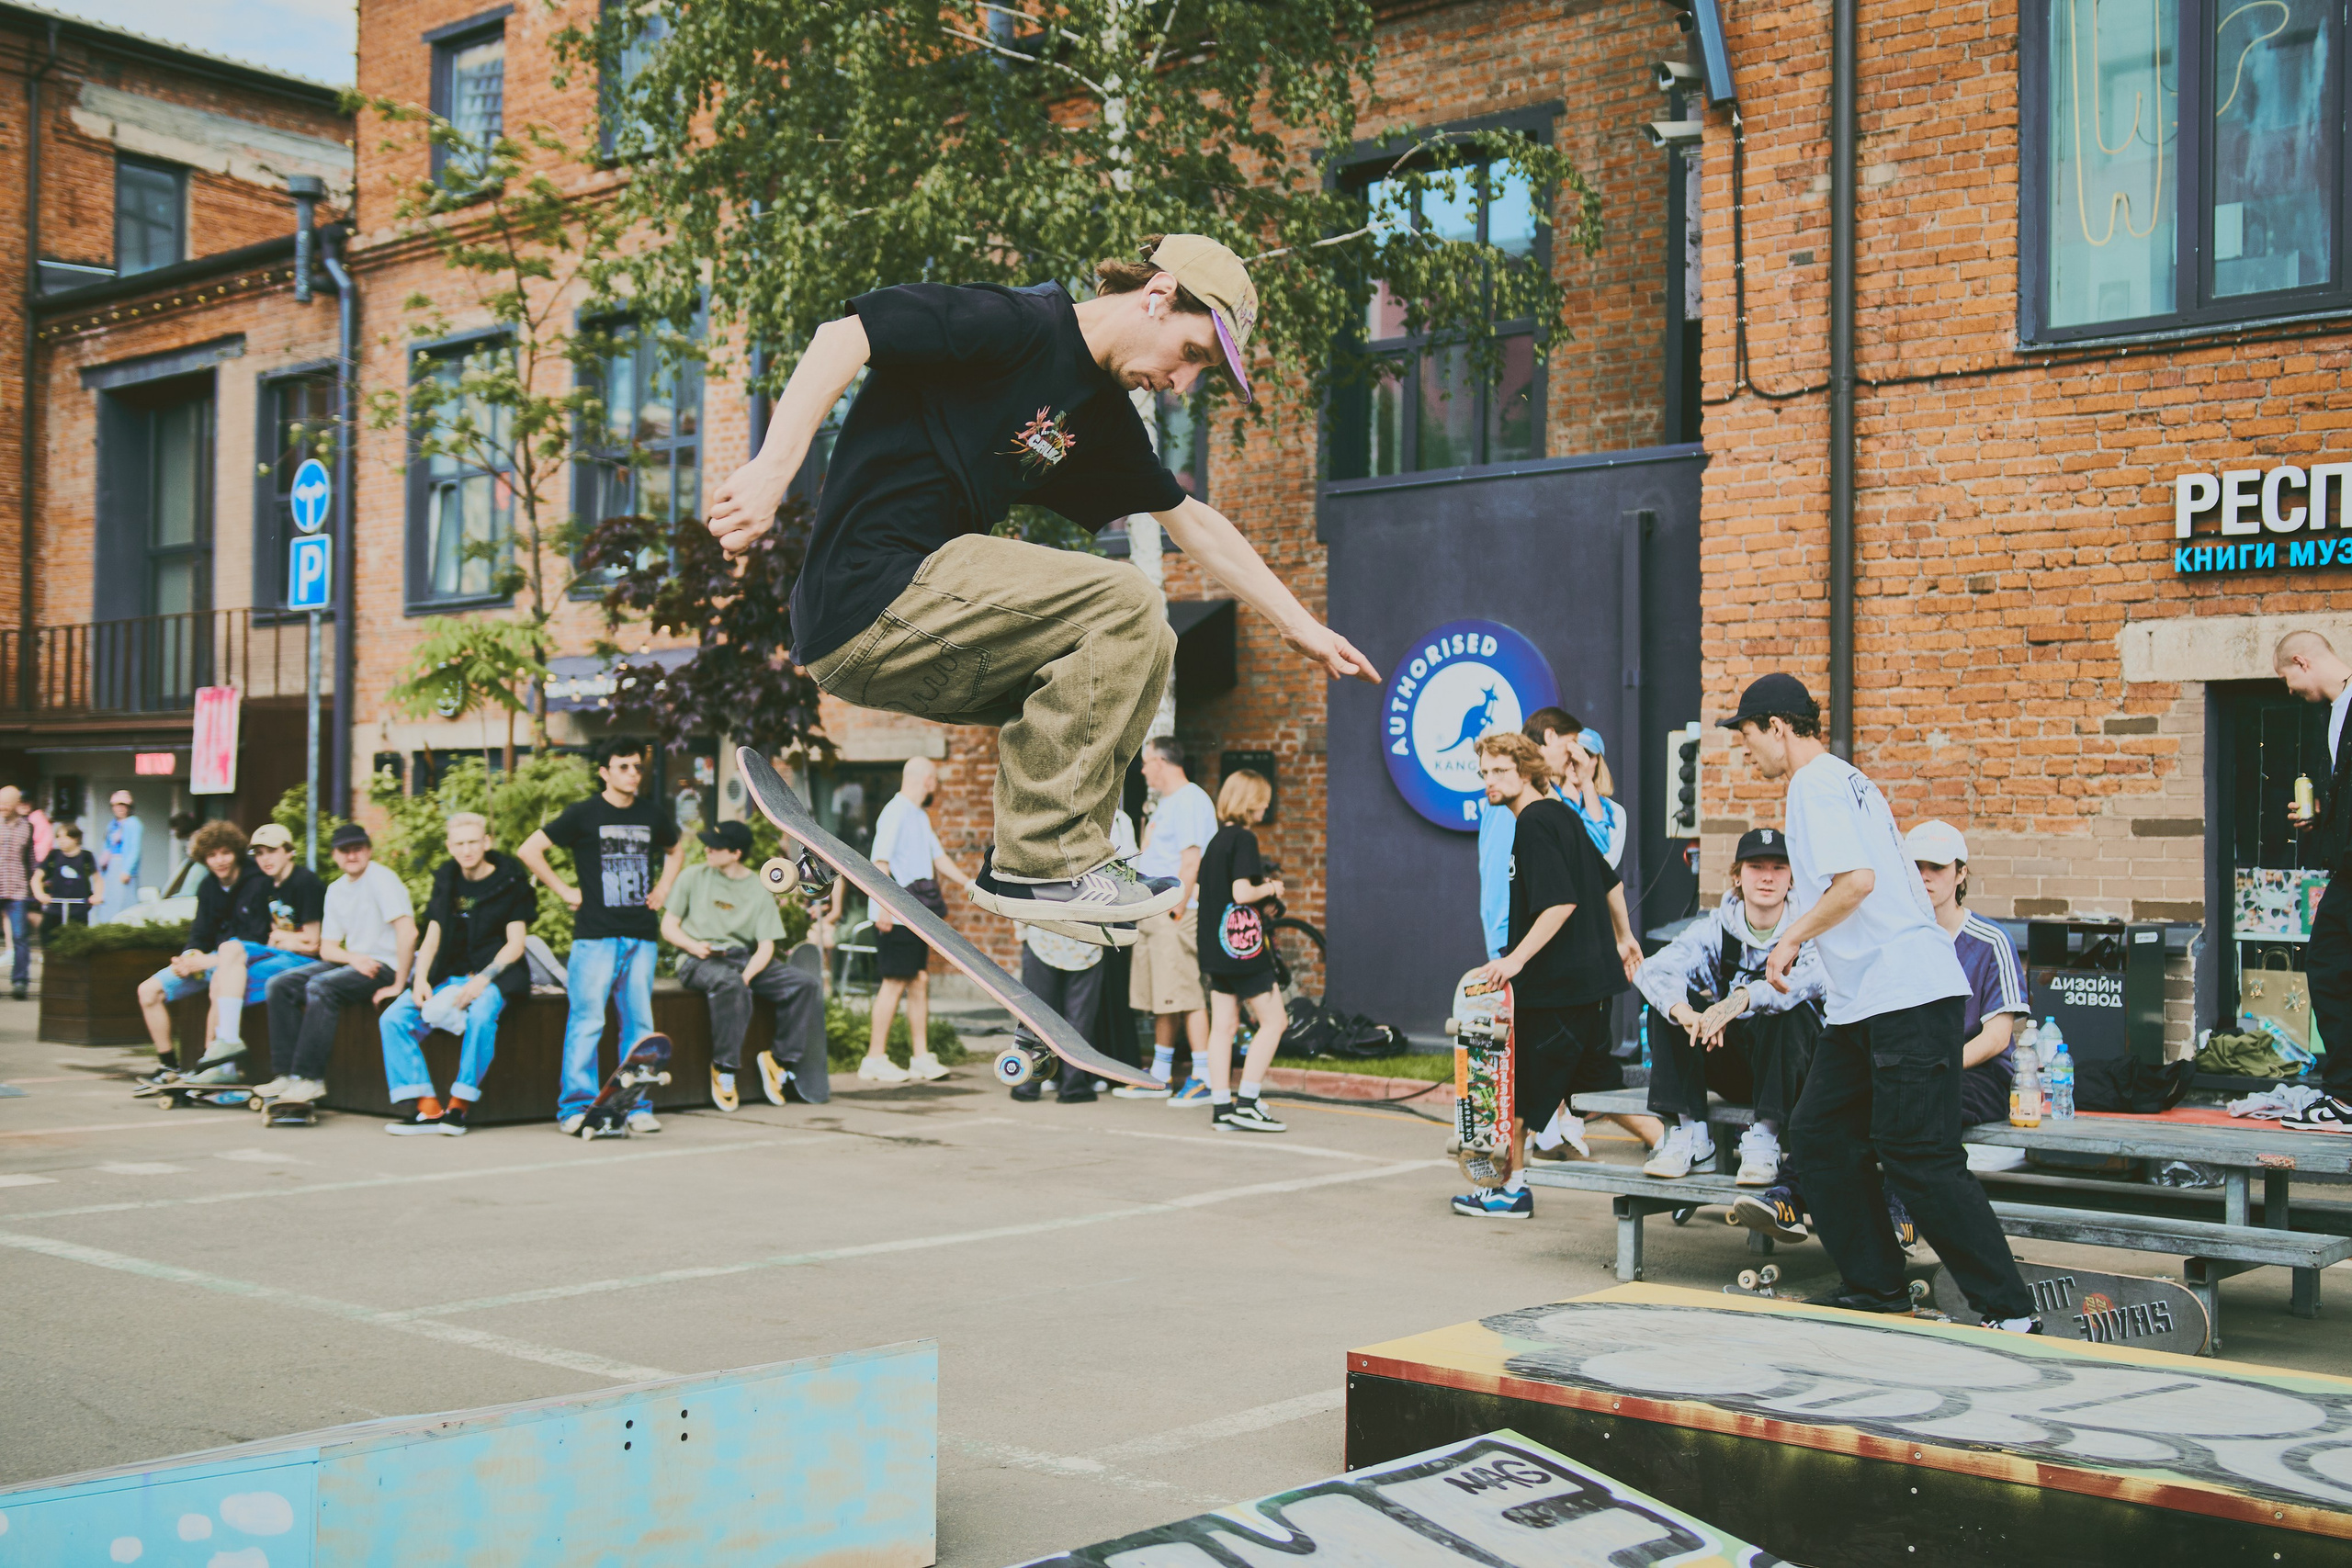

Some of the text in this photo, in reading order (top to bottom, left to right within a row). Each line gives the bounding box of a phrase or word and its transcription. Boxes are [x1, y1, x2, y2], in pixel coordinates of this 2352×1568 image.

[2176, 463, 2352, 539] РЕСП
[298, 544, 323, 603] P
[2175, 536, 2352, 572] КНИГИ МУЗ
[1389, 633, 1498, 756] AUTHORISED
[1434, 760, 1477, 771] KANG
[2073, 1301, 2174, 1343] SHAKE
